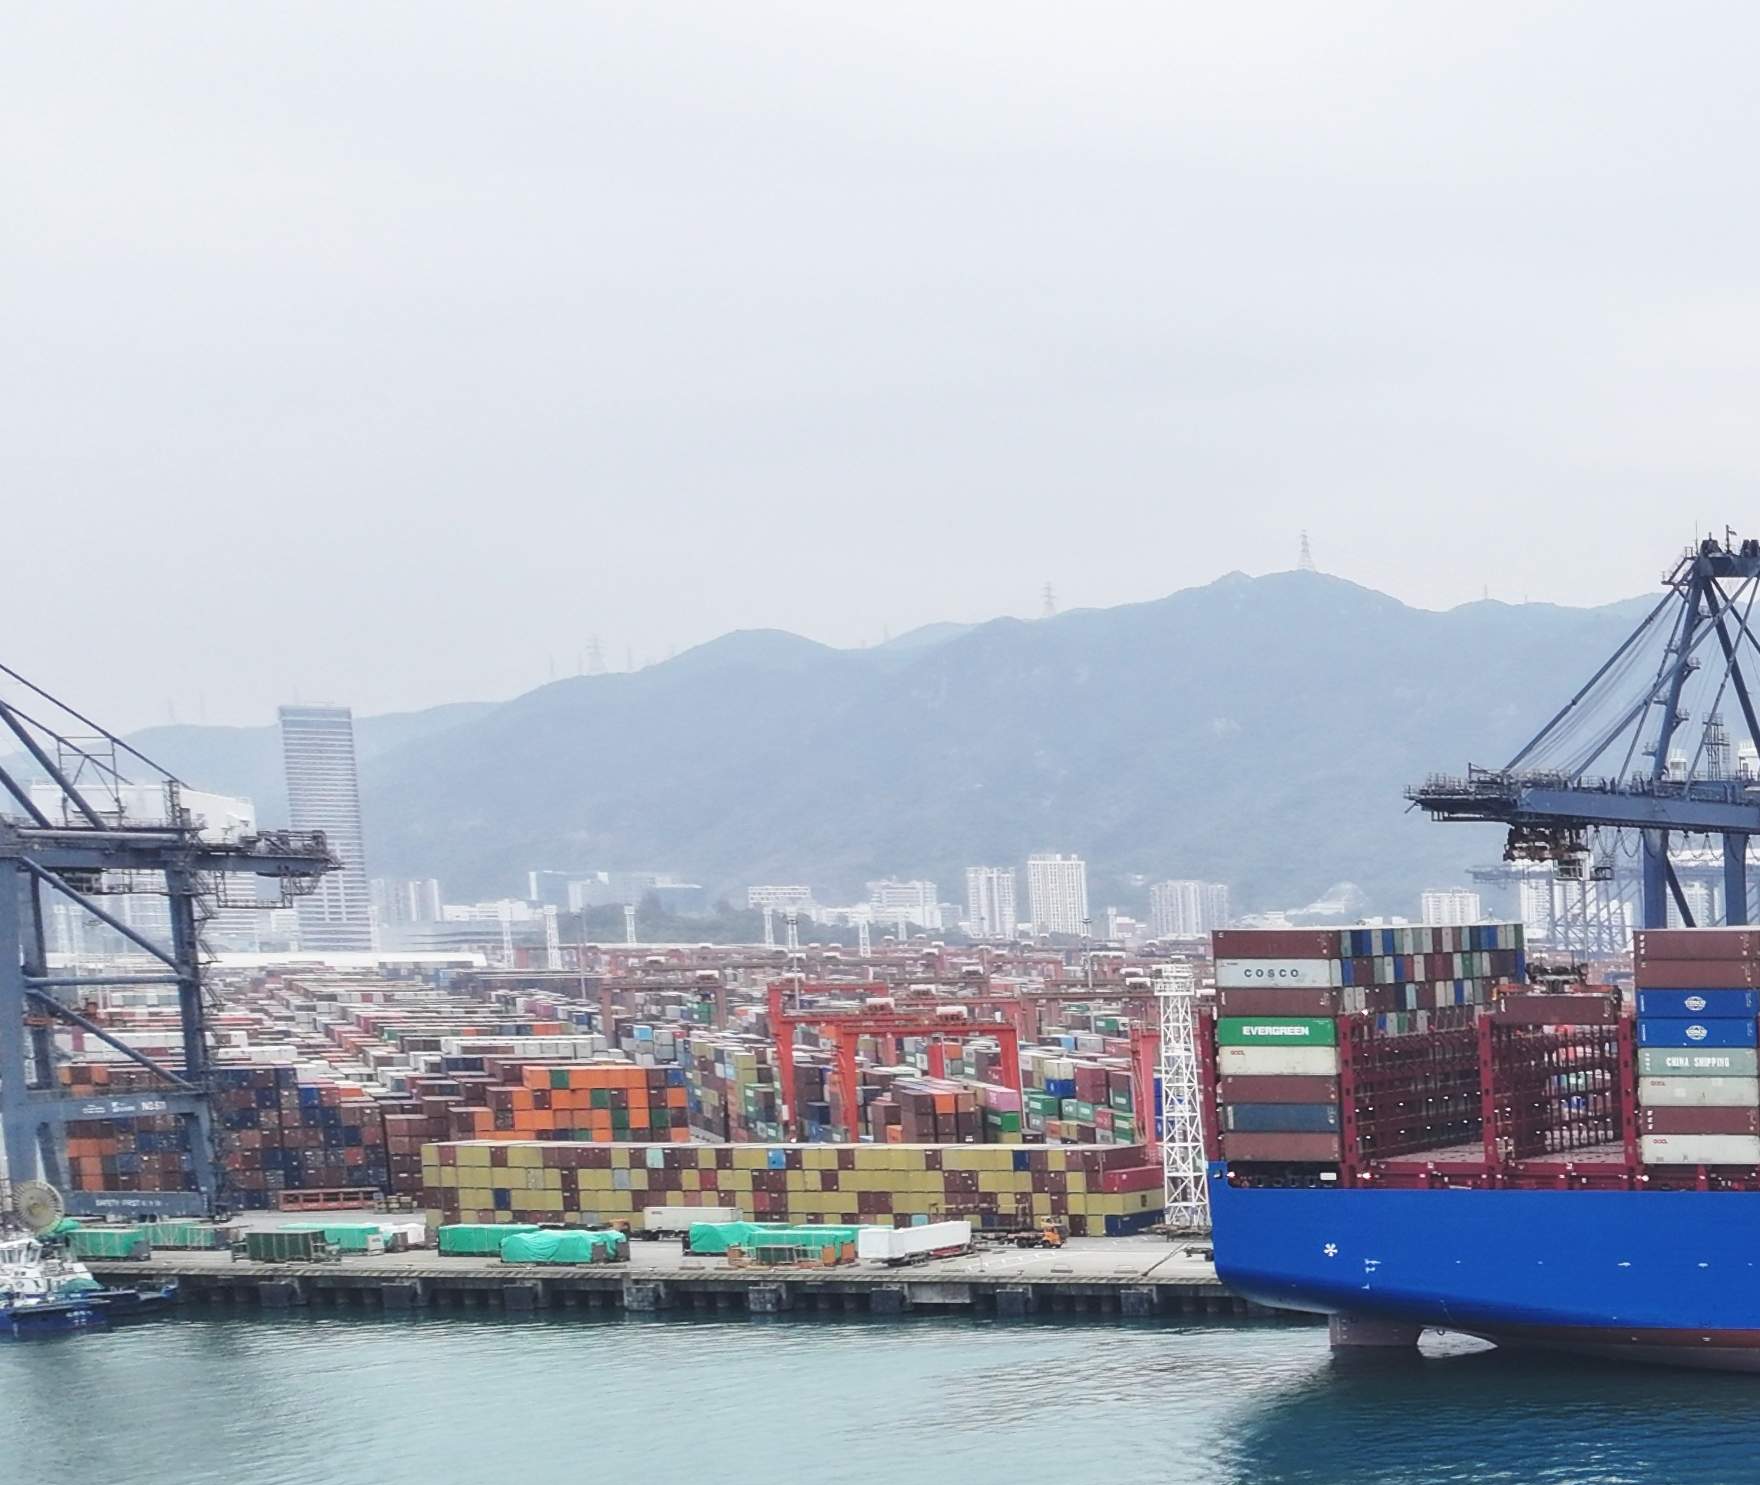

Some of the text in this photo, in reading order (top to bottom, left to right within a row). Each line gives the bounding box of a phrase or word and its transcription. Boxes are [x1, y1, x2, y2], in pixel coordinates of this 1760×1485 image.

[1244, 968, 1299, 978] COSCO
[1242, 1025, 1310, 1036] EVERGREEN
[1666, 1056, 1730, 1068] CHINA SHIPPING
